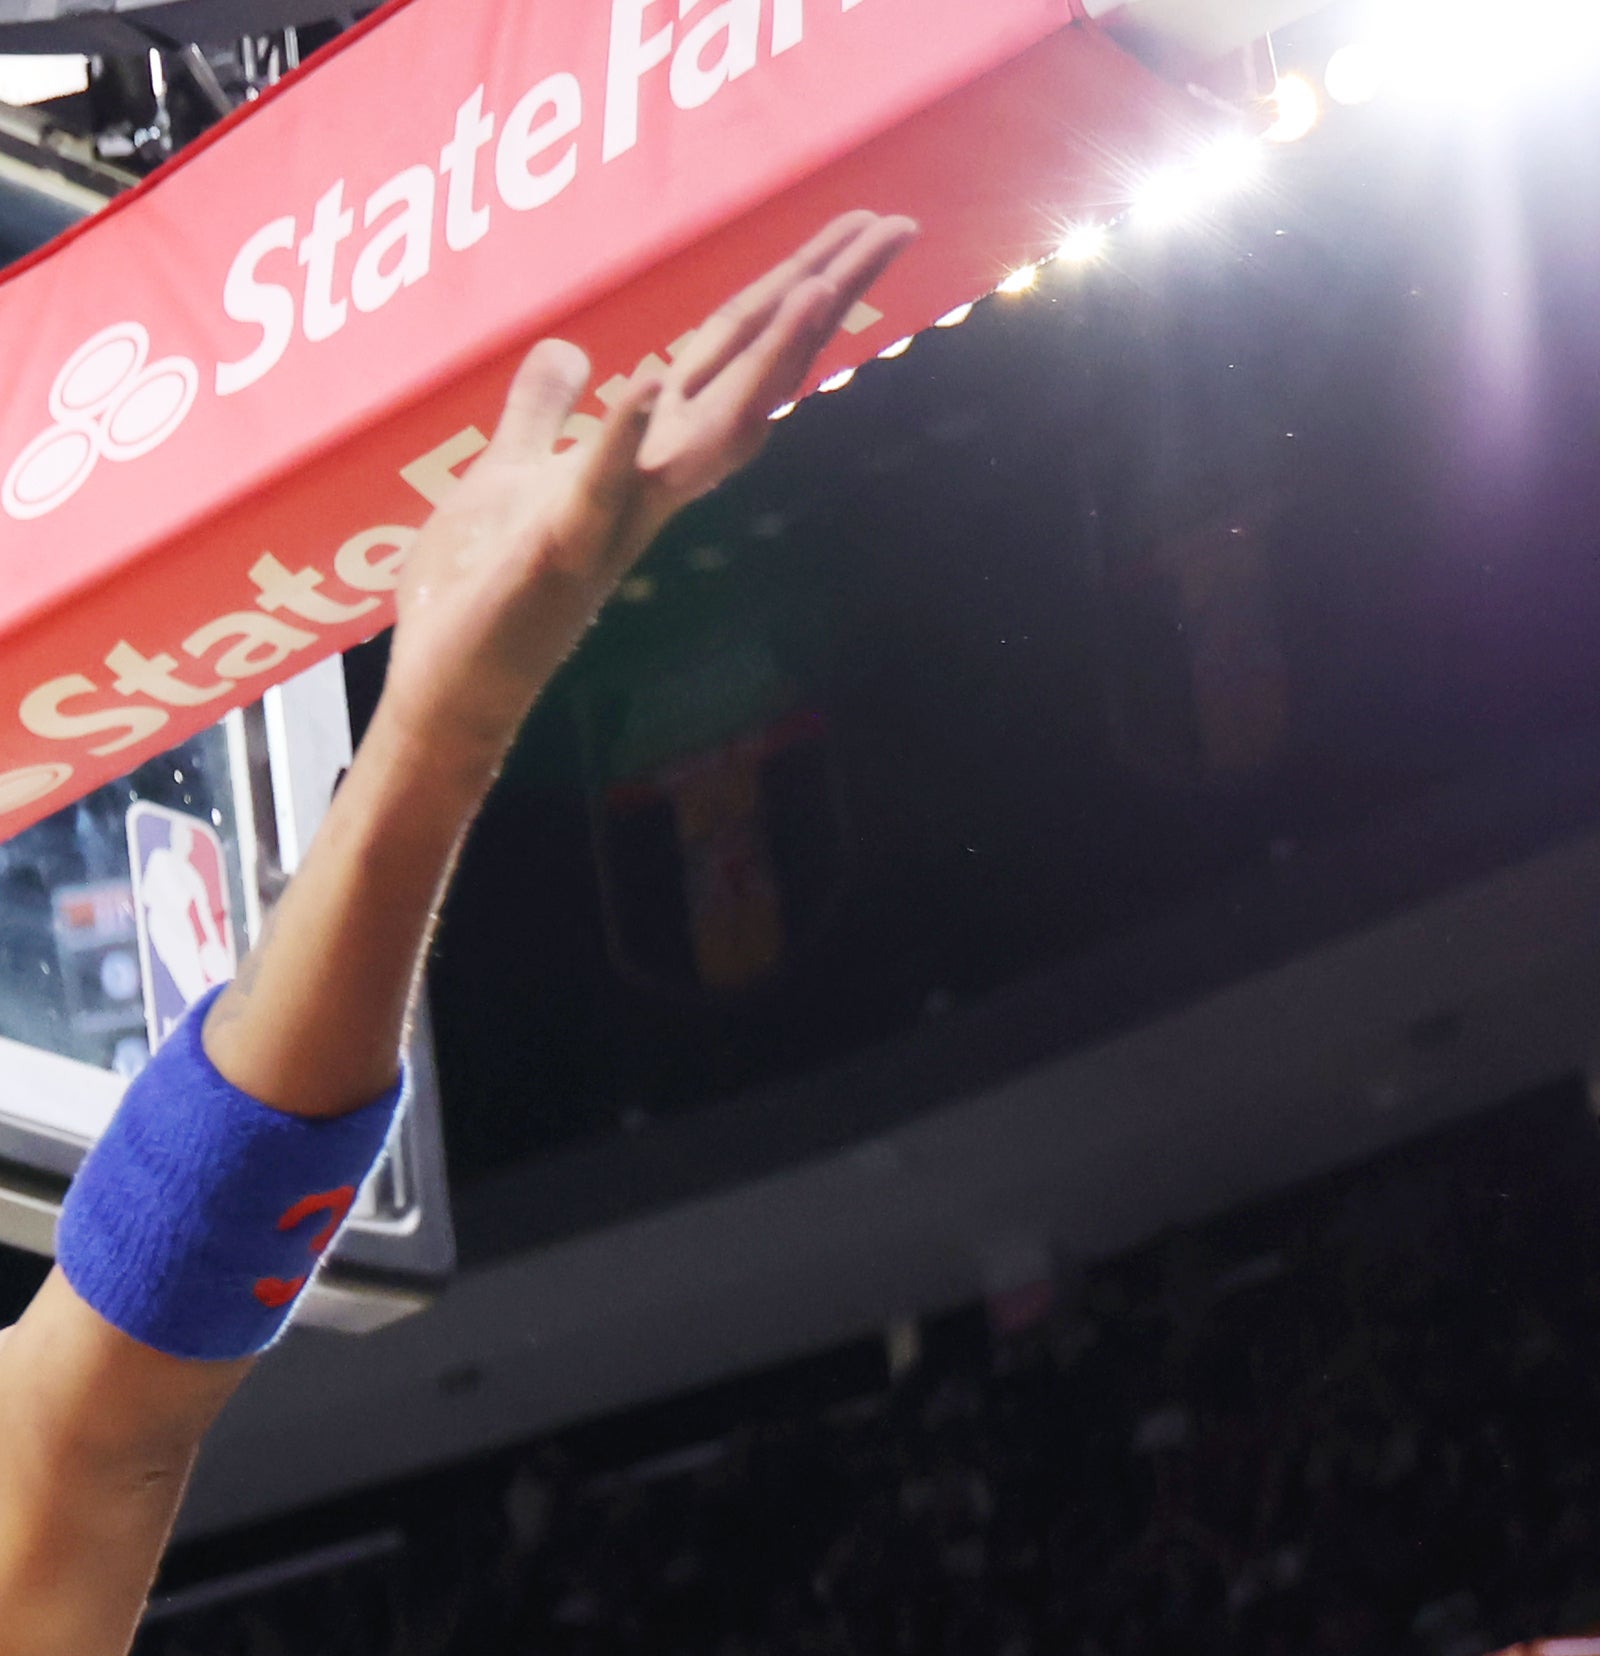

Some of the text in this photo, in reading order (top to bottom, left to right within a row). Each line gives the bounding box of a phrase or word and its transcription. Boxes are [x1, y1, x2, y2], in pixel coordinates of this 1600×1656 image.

[215, 0, 866, 396] State Fa
[19, 524, 420, 757] State
